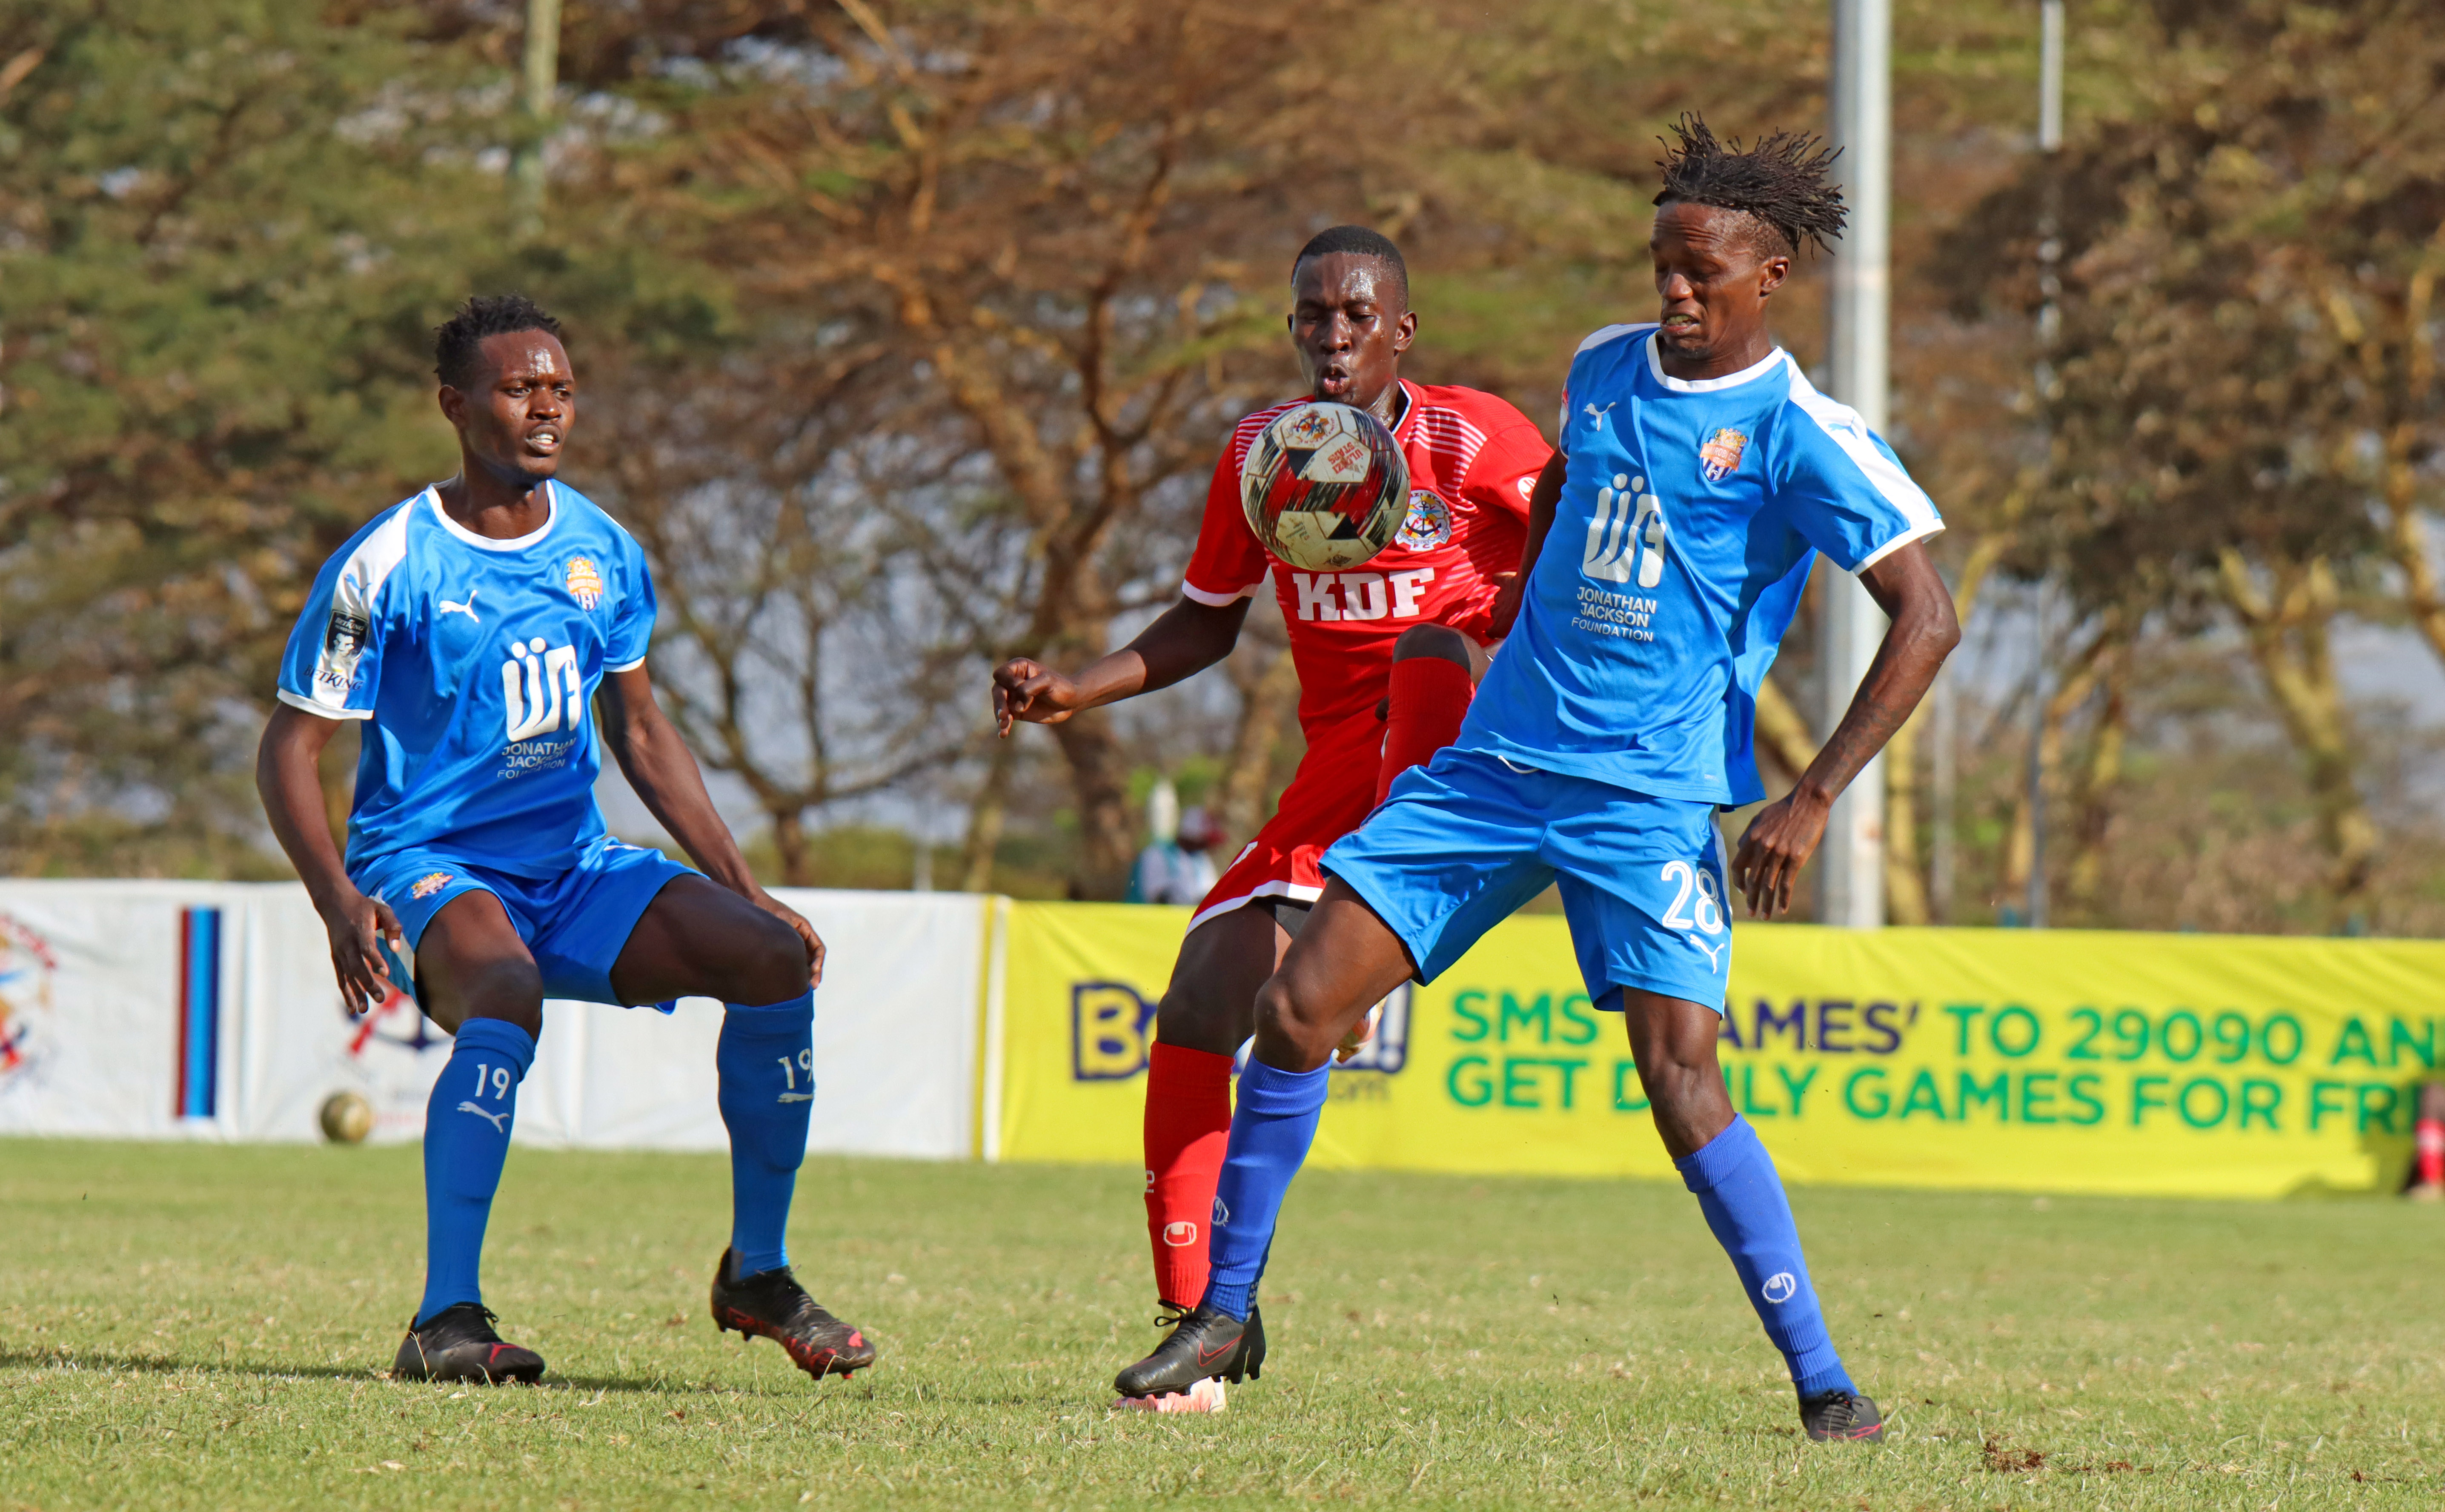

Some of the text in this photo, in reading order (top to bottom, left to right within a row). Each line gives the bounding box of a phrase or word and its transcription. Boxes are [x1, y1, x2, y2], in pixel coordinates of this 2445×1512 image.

[1292, 567, 1435, 621] KDF
[1577, 586, 1657, 614] JONATHAN
[1571, 617, 1653, 642] FOUNDATION
[1580, 602, 1649, 627] JACKSON
[502, 737, 576, 755] JONATHAN
[497, 759, 565, 779] FOATION
[1661, 860, 1724, 934] 28
[1450, 990, 1598, 1045] SMS
[1717, 999, 1921, 1054] AMES'
[1944, 1003, 2041, 1058] TO
[2067, 1008, 2303, 1065] 29090
[2331, 1017, 2436, 1068] AN
[475, 1064, 510, 1100] 19
[778, 1048, 813, 1090] 19
[1447, 1055, 1591, 1109] GET
[1615, 1061, 1818, 1117] DILY
[1844, 1065, 2105, 1126] GAMES
[2133, 1075, 2282, 1131] FOR
[2310, 1081, 2422, 1133] FR
